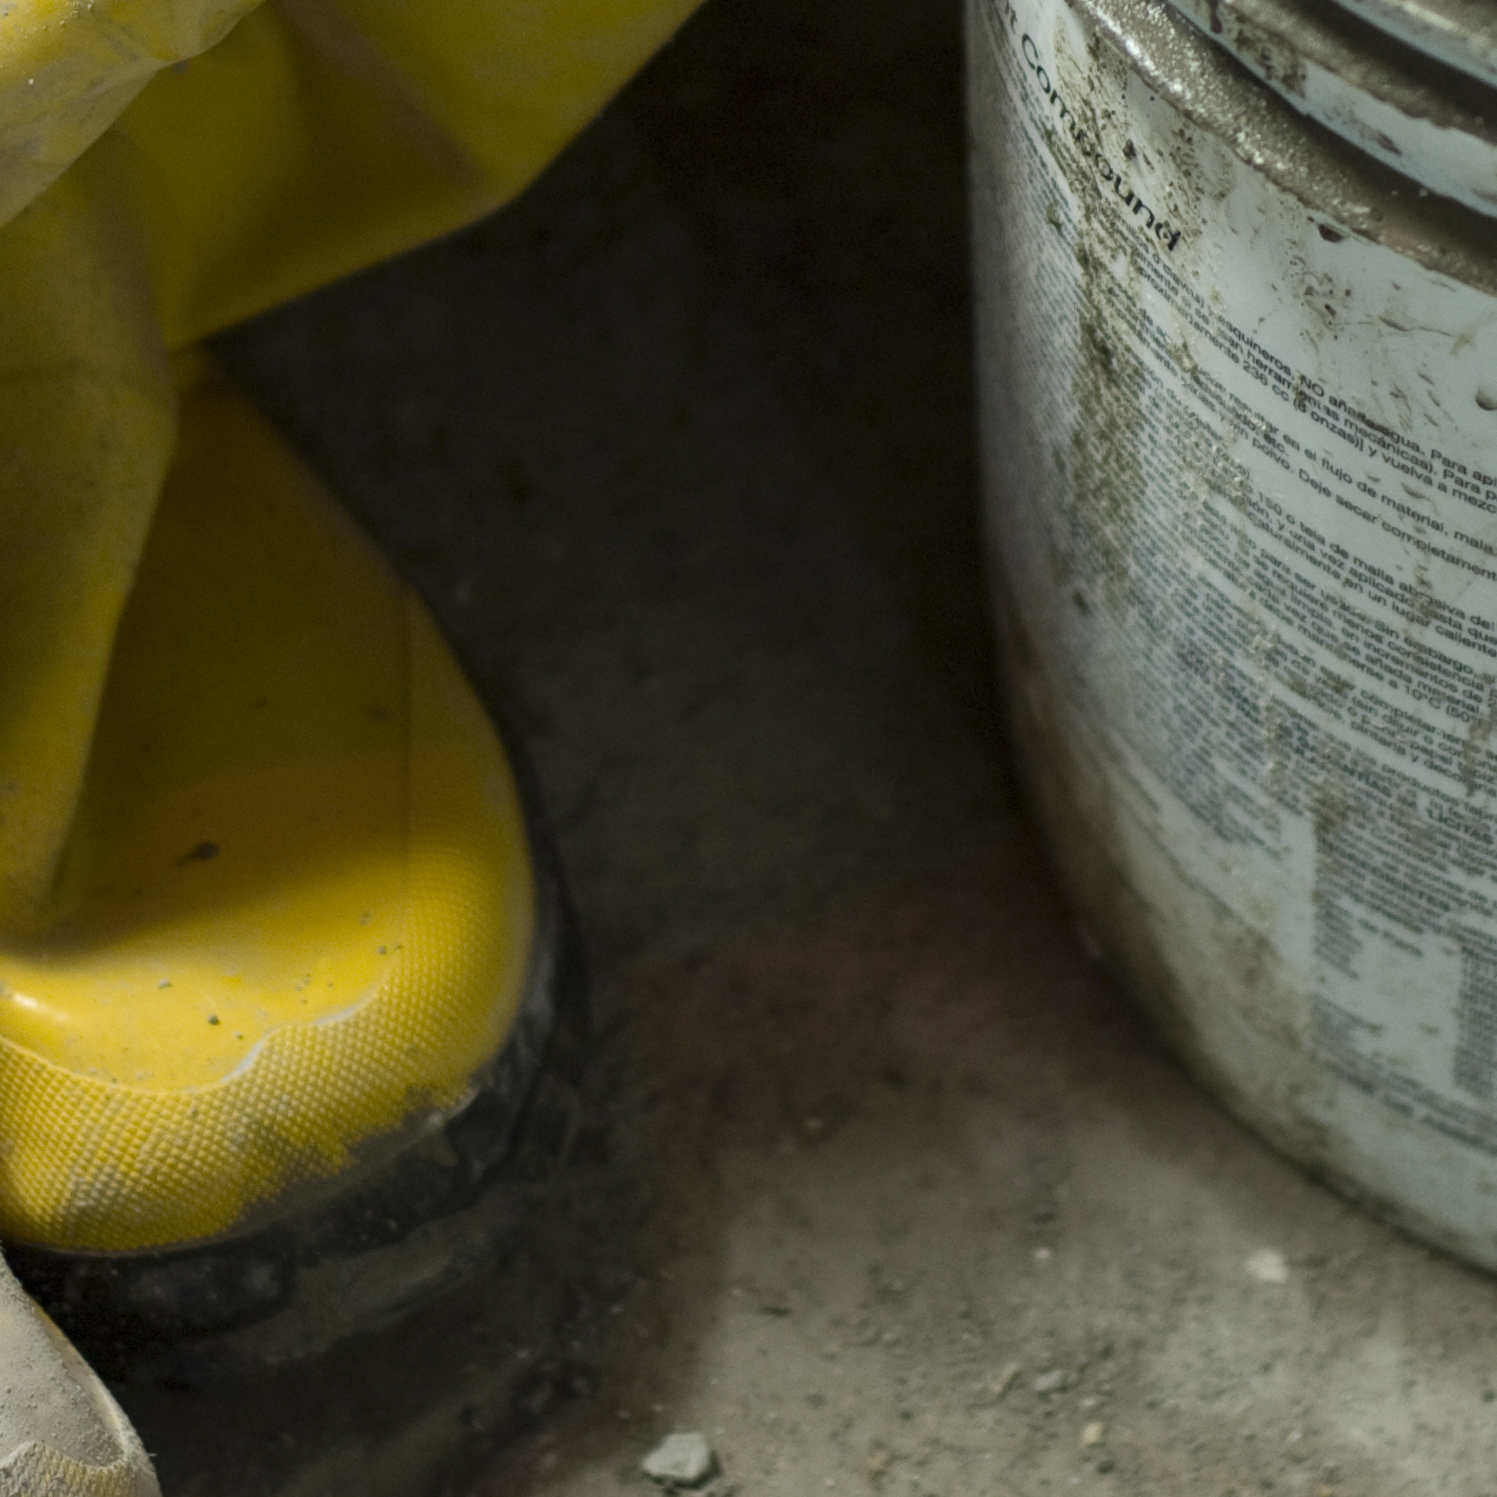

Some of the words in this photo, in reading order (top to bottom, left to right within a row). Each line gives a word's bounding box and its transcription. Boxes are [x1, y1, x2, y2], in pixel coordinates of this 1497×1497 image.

[1271, 383, 1289, 402] cc
[1310, 409, 1364, 452] onzas)]
[1368, 444, 1377, 458] y
[1381, 452, 1432, 486] vuelva
[1437, 480, 1447, 493] a
[1299, 372, 1324, 398] NO
[1431, 447, 1467, 476] Para
[1252, 436, 1293, 473] polvo.
[1298, 466, 1331, 498] Deje
[1335, 493, 1377, 524] secar
[1282, 432, 1299, 452] en
[1304, 447, 1316, 462] el
[1321, 456, 1352, 485] flujo
[1356, 479, 1376, 499] de
[1381, 493, 1448, 536] material,
[1453, 529, 1493, 555] mala
[1443, 467, 1480, 495] Para
[1286, 512, 1295, 526] o
[1299, 519, 1325, 546] tela
[1329, 541, 1348, 560] de
[1353, 555, 1393, 585] malla
[1289, 529, 1315, 552] una
[1319, 548, 1344, 570] vez
[1348, 566, 1414, 609] aplicado
[1420, 602, 1462, 631] asta
[1467, 626, 1497, 646] que
[1294, 571, 1317, 591] ser
[1374, 618, 1399, 640] Sin
[1344, 576, 1363, 594] en
[1368, 589, 1387, 607] un
[1391, 601, 1430, 628] lugar
[1434, 624, 1497, 658] caliente.
[1332, 609, 1383, 644] menos
[1363, 640, 1458, 693] incrementos
[1462, 688, 1483, 704] de
[1364, 653, 1412, 685] añada
